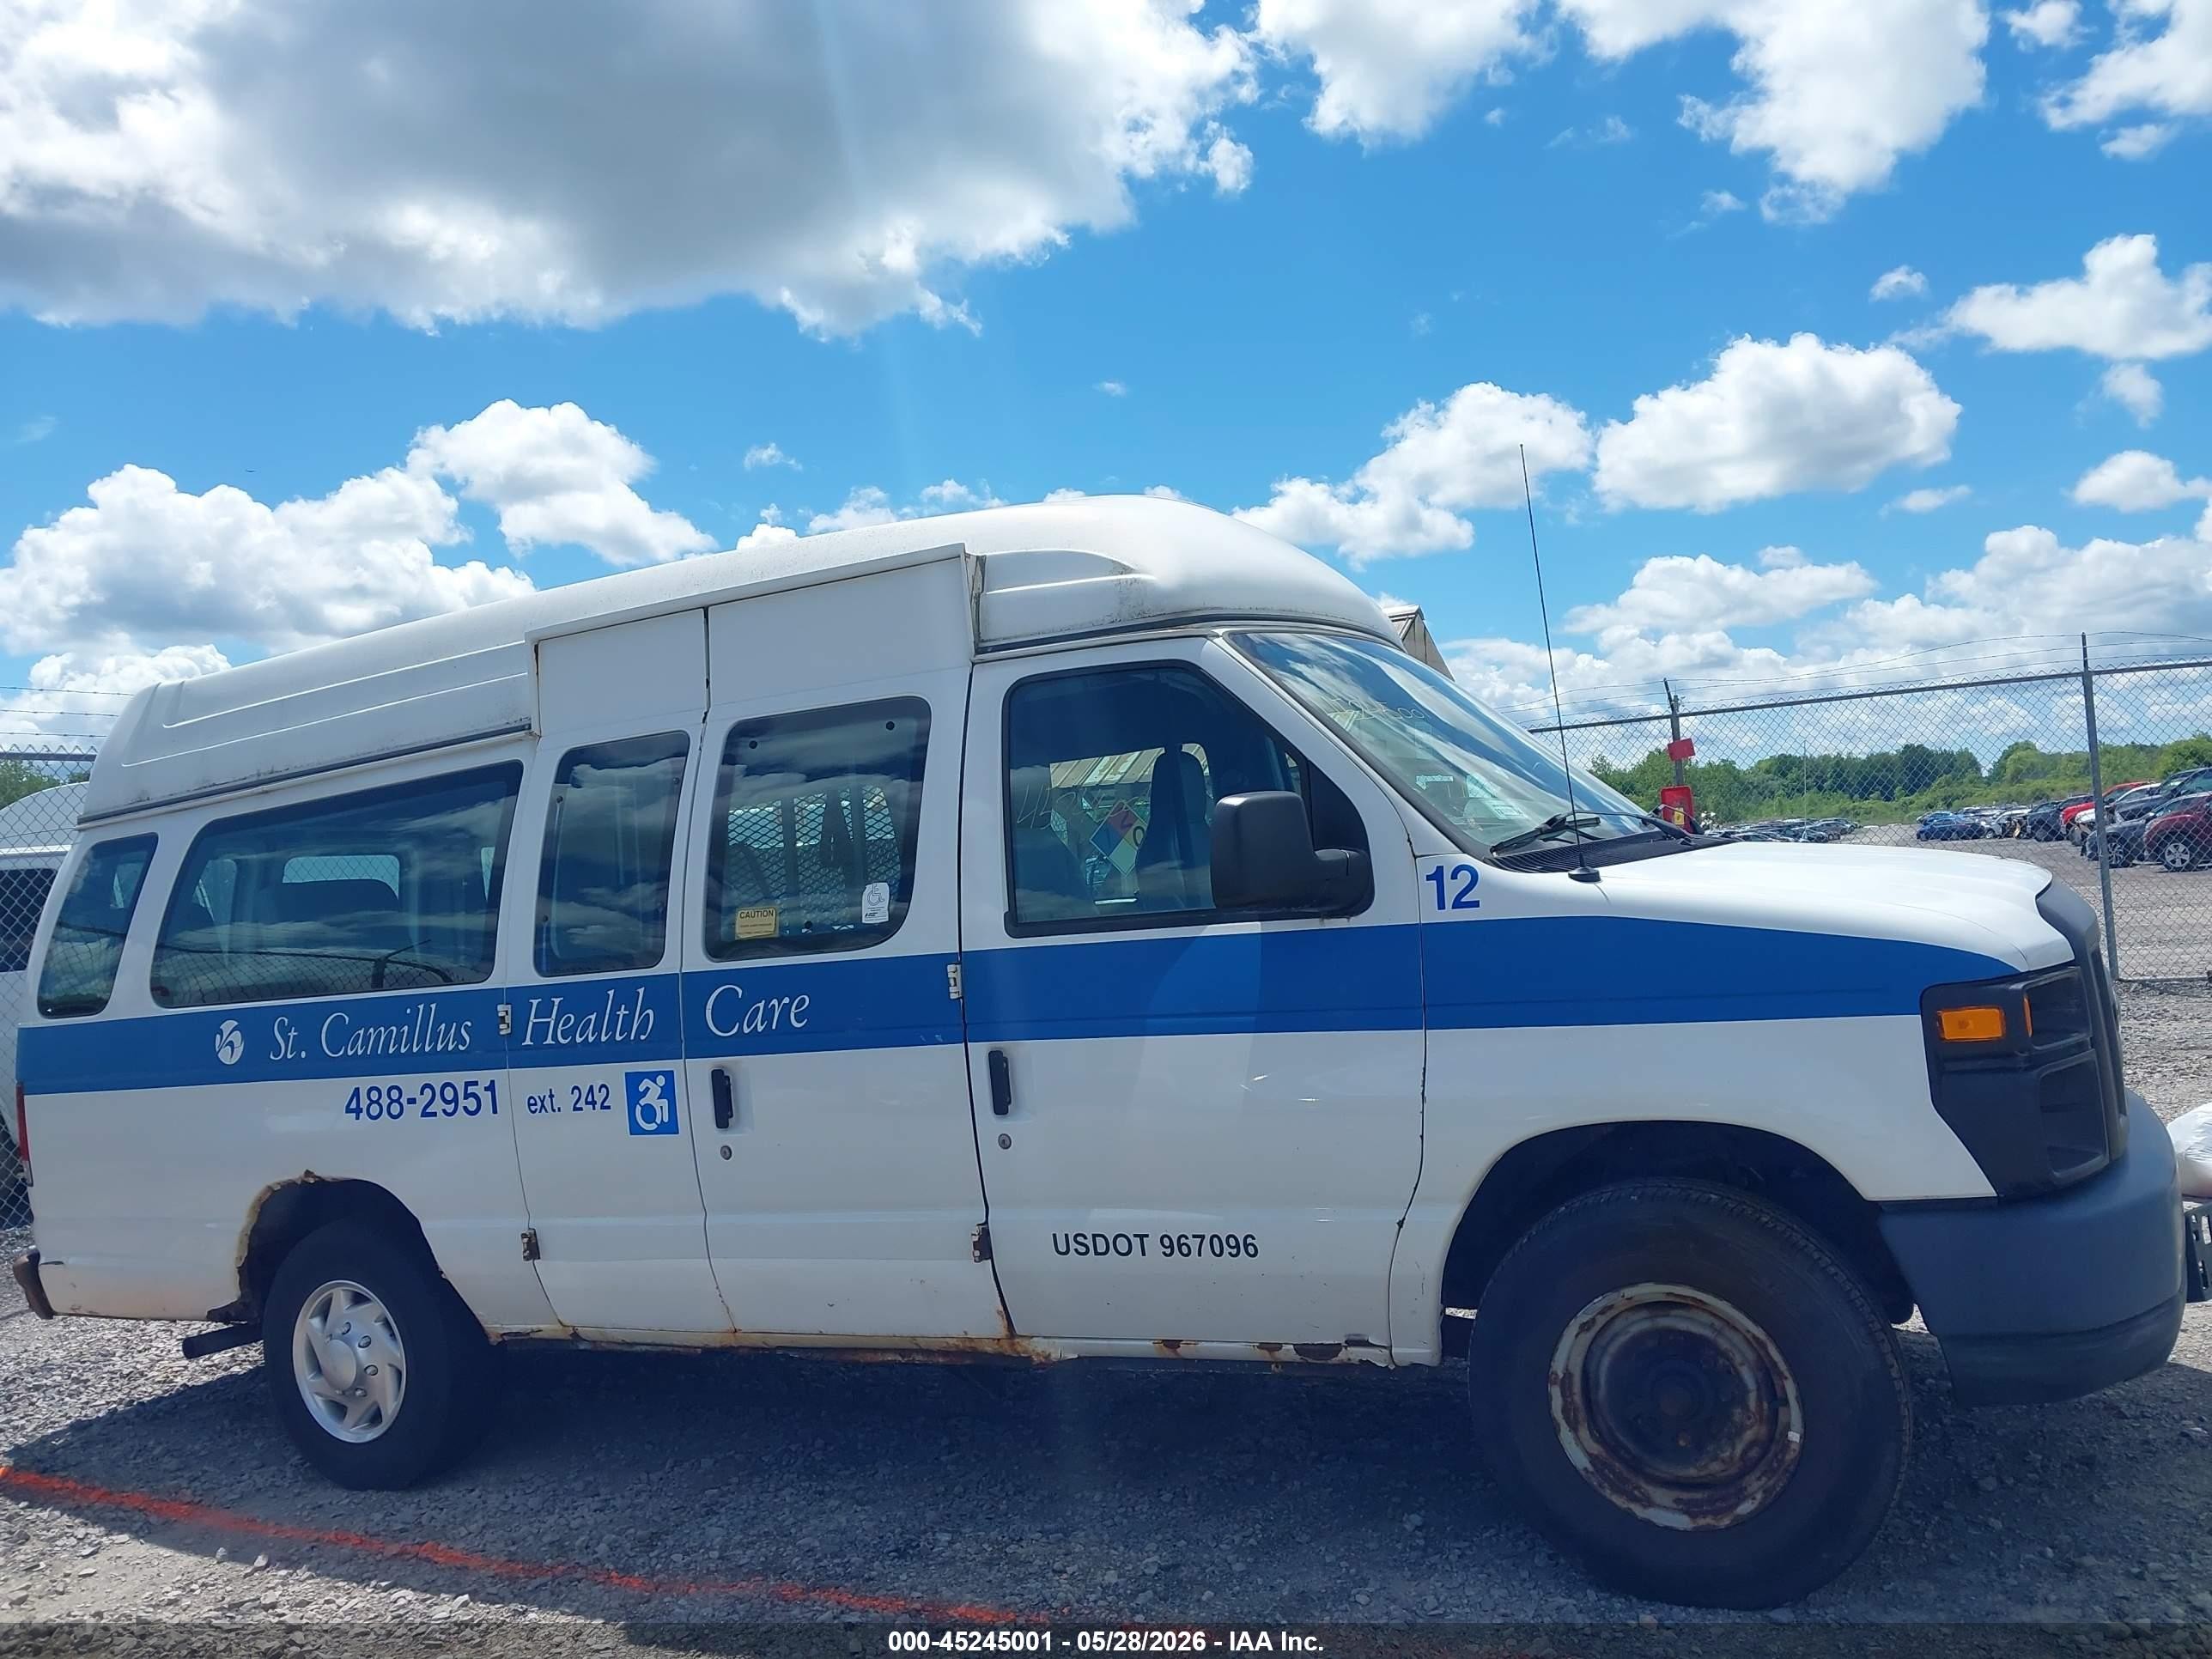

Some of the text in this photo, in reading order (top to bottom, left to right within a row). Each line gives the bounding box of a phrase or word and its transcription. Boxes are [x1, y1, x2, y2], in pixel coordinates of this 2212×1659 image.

[1425, 863, 1480, 911] 12
[739, 909, 775, 919] CAUTION
[270, 984, 811, 1061] St. Camillus Health Care
[344, 1079, 612, 1121] 488-2951 ext. 242
[1052, 1232, 1260, 1259] USDOT 967096
